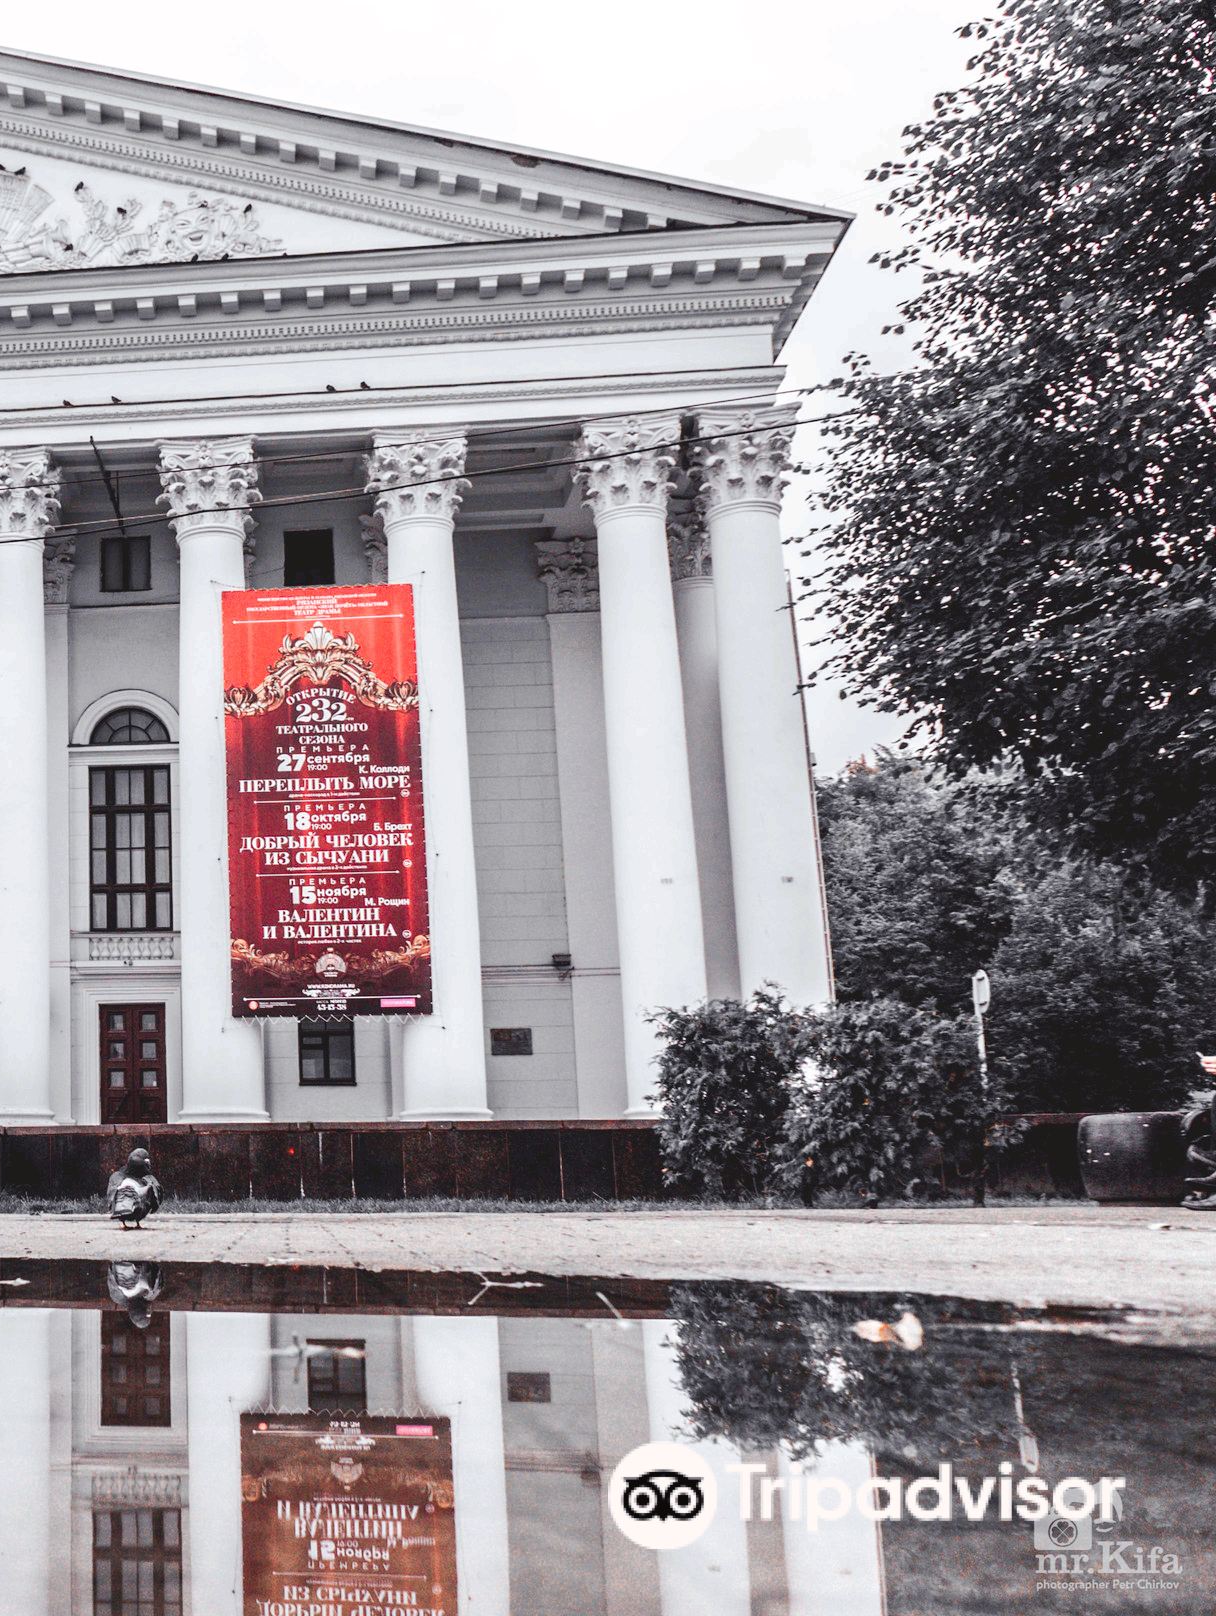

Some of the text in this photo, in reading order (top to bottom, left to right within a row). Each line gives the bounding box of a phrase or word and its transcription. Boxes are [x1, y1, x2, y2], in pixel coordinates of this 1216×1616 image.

[286, 687, 357, 706] ОТКРЫТИЕ
[276, 722, 369, 735] ТЕАТРАЛЬНОГО
[299, 732, 345, 744] СЕЗОНА
[276, 744, 370, 753] ПРЕМЬЕРА
[277, 752, 370, 772] 27 сентября
[239, 774, 411, 793] ПЕРЕПЛЫТЬ МОРЕ
[284, 802, 366, 812] ПРЕМЬЕРА
[284, 810, 367, 831] 18 октября
[373, 823, 382, 832] Б.
[384, 822, 413, 832] Брехт
[239, 832, 414, 853] ДОБРЫЙ ЧЕЛОВЕК
[264, 851, 290, 866] ИЗ
[295, 850, 390, 865] СЫЧУАНИ
[289, 877, 366, 886] ПРЕМЬЕРА
[290, 885, 367, 905] 15 ноября
[364, 898, 376, 906] М.
[378, 897, 411, 907] Рощин
[278, 907, 381, 923] ВАЛЕНТИН
[262, 925, 277, 940] И
[282, 923, 397, 940] ВАЛЕНТИНА
